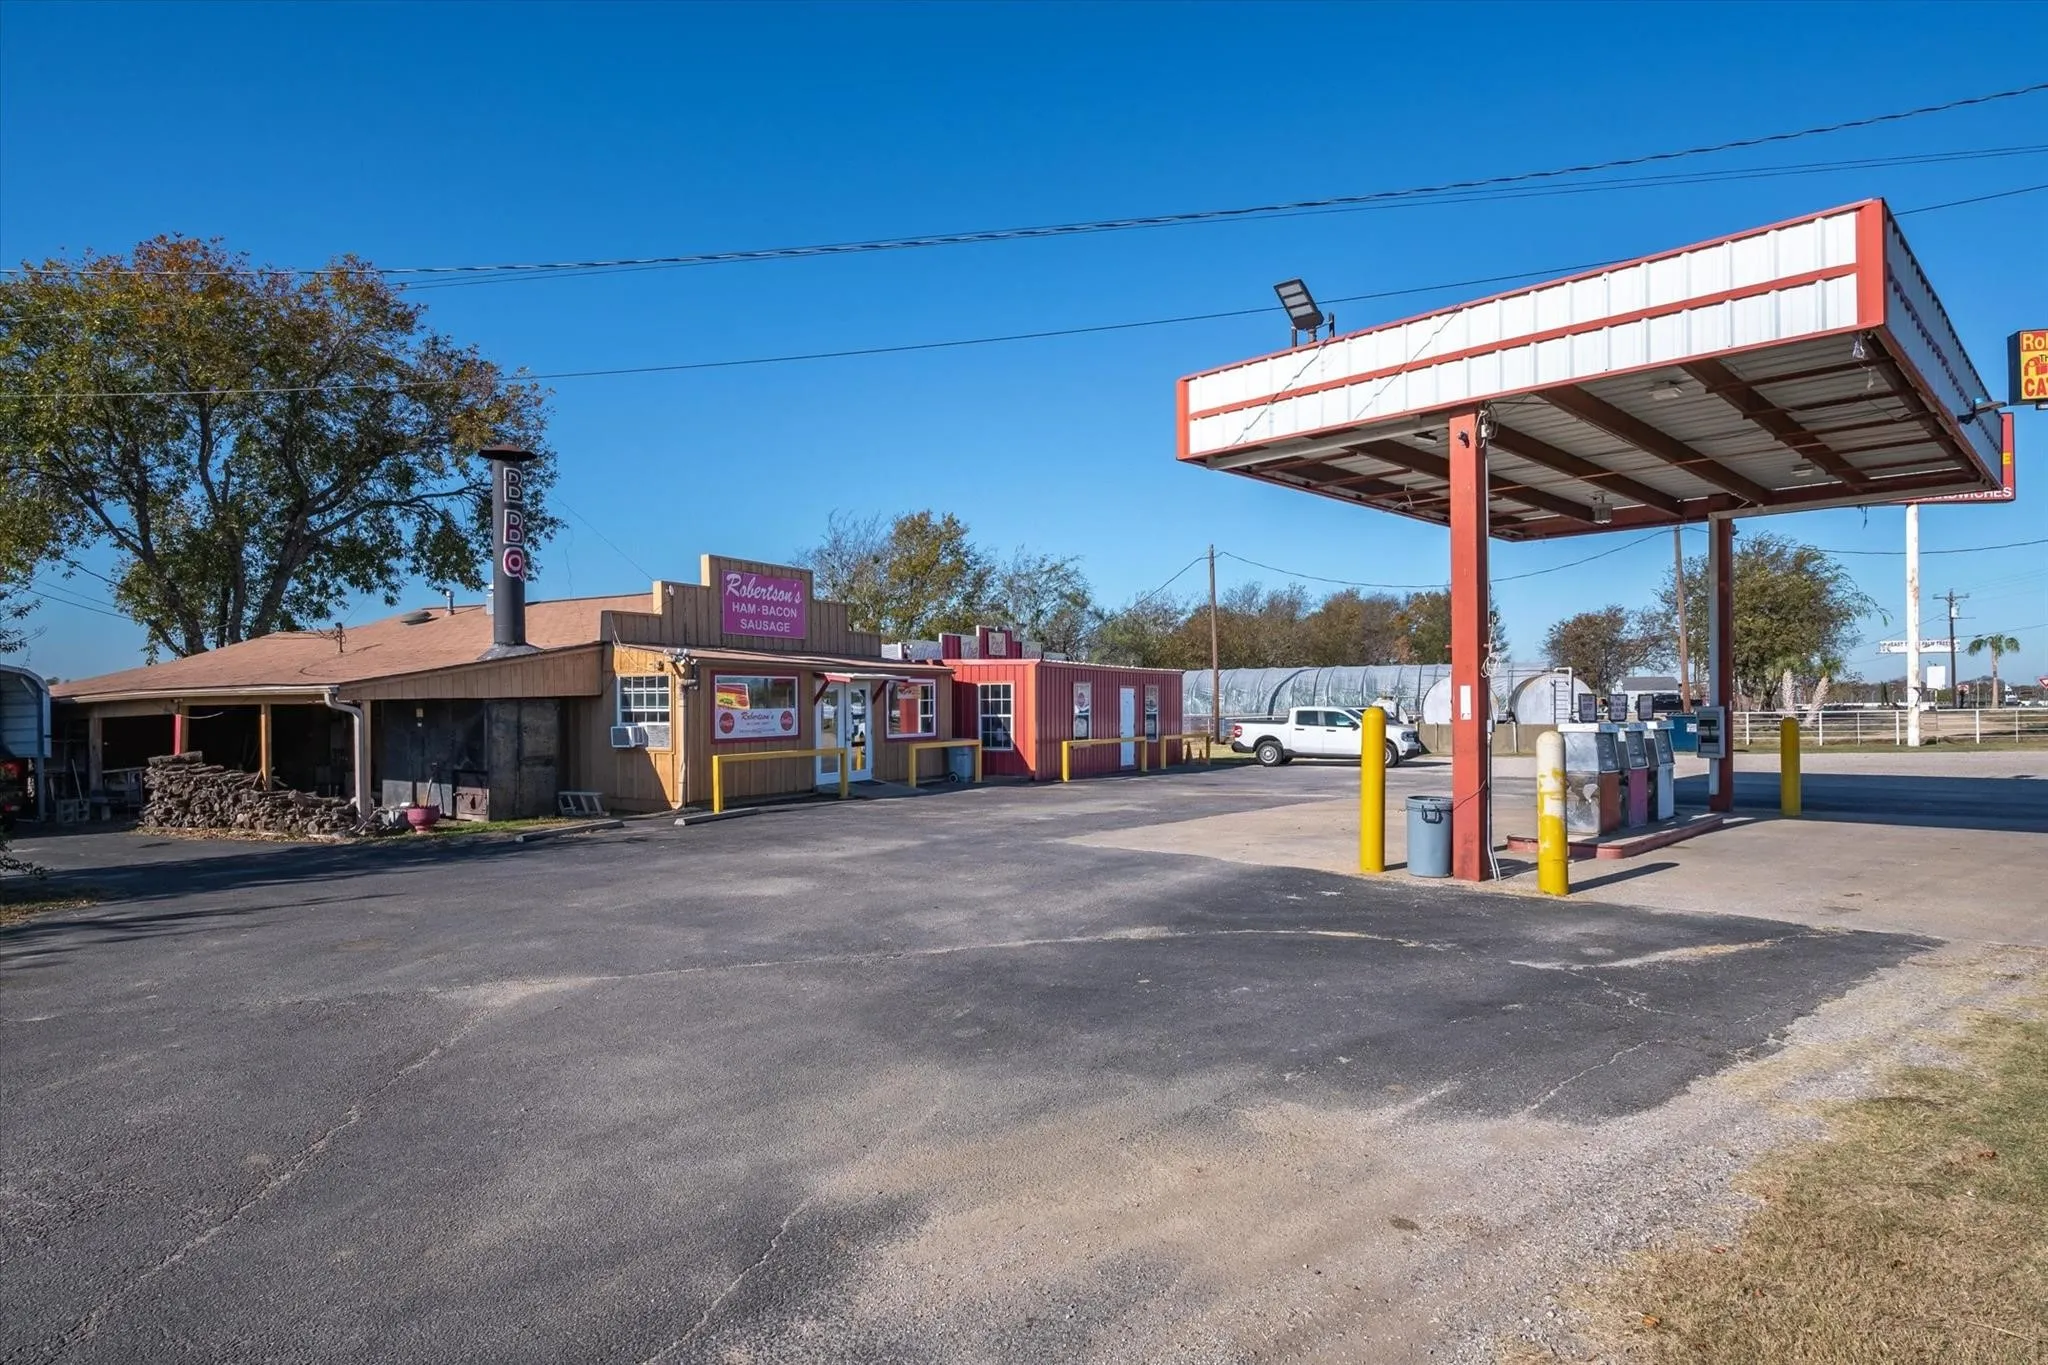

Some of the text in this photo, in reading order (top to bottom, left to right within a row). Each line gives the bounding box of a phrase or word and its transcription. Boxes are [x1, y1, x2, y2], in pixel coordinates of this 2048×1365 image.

[2022, 333, 2048, 351] Ro
[2024, 378, 2048, 397] CA
[503, 466, 526, 582] BBQ
[726, 573, 803, 604] Robertson's
[740, 618, 791, 633] SAUSAGE
